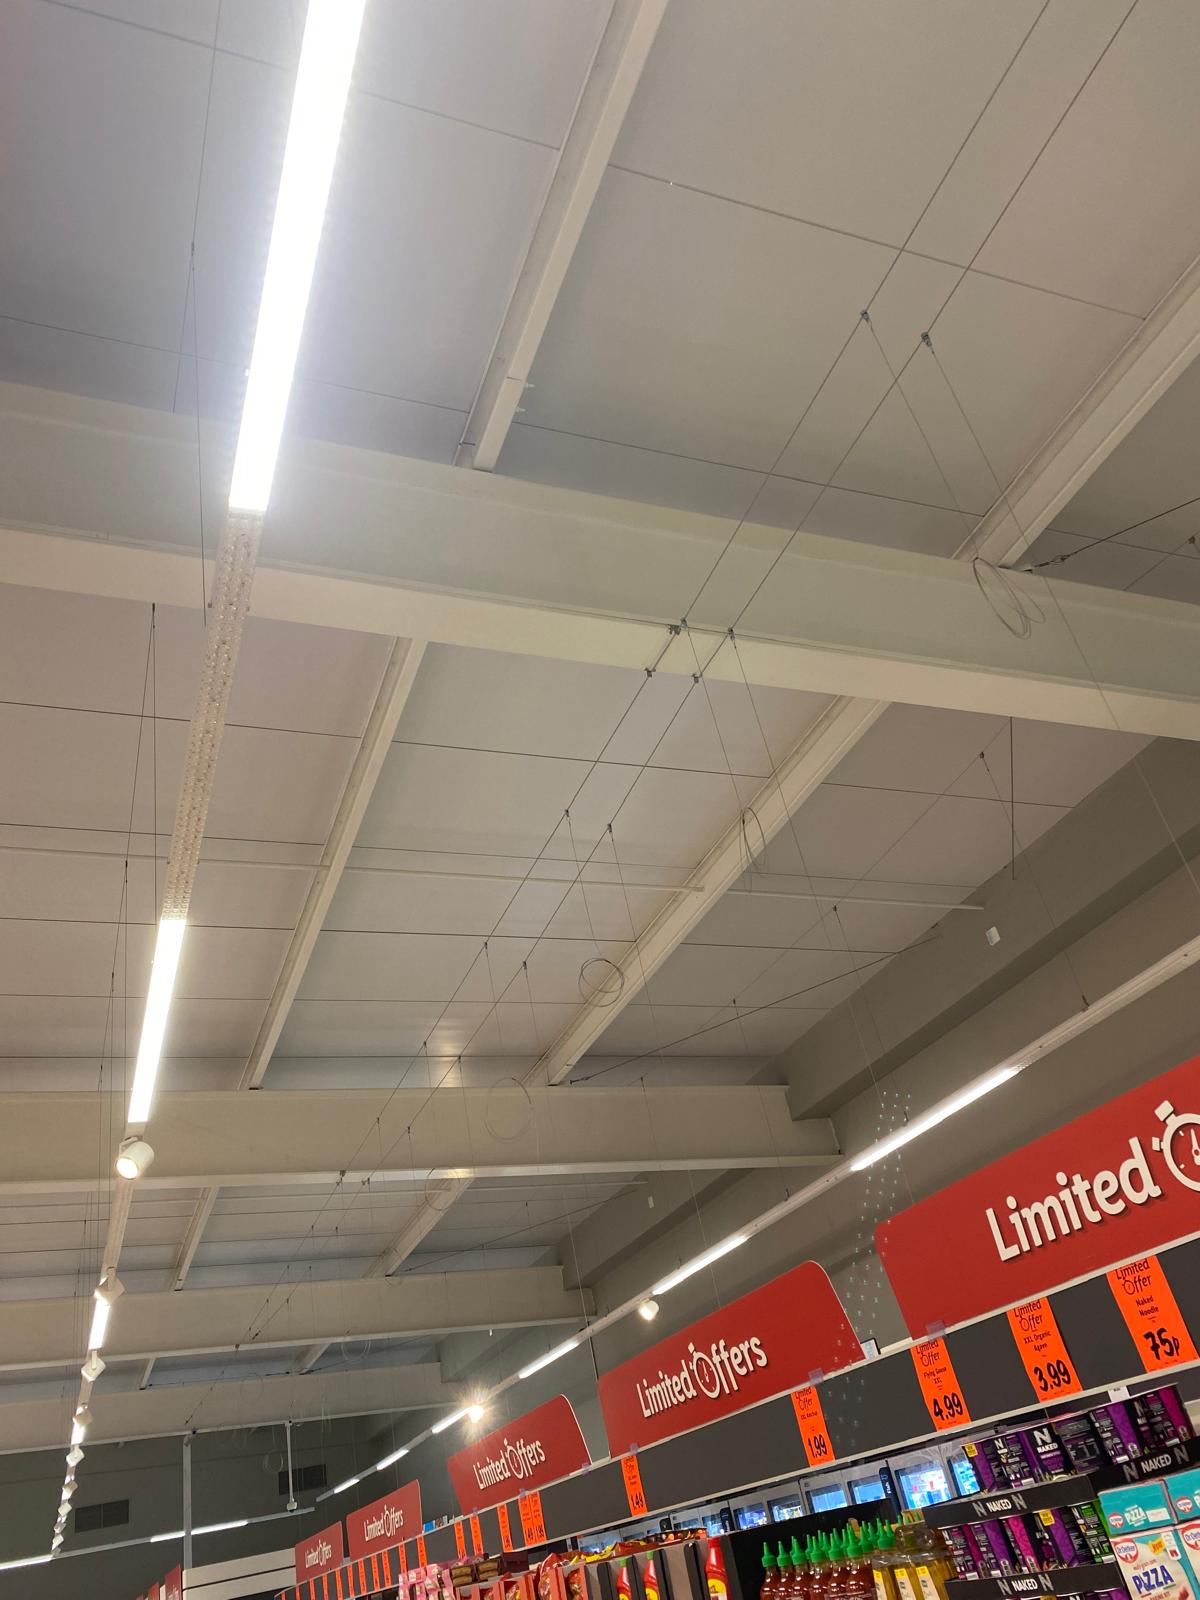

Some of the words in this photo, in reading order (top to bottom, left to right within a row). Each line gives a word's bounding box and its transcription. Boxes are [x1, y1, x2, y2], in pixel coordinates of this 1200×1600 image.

[986, 1136, 1162, 1262] Limited
[1115, 1258, 1150, 1280] Limited
[1122, 1274, 1152, 1295] Offer
[1013, 1299, 1042, 1318] Limited
[1135, 1295, 1154, 1307] Naked
[1019, 1314, 1043, 1332] Offer
[1143, 1327, 1180, 1360] 75p
[920, 1351, 940, 1367] Offer
[636, 1359, 697, 1418] Limited
[688, 1336, 768, 1399] Offers
[1034, 1359, 1071, 1392] 3.99
[933, 1392, 963, 1421] 4.99
[808, 1433, 828, 1459] 1.99
[1033, 1428, 1052, 1446] N
[1036, 1443, 1059, 1453] NAKED
[473, 1449, 511, 1490] Limited
[504, 1438, 546, 1479] Offers
[1140, 1453, 1172, 1474] NAKED
[985, 1498, 1012, 1512] NAKED
[363, 1512, 384, 1542] Limited
[384, 1504, 404, 1537] Offers
[1011, 1578, 1038, 1592] NAKED
[1132, 1564, 1175, 1594] PIZZA
